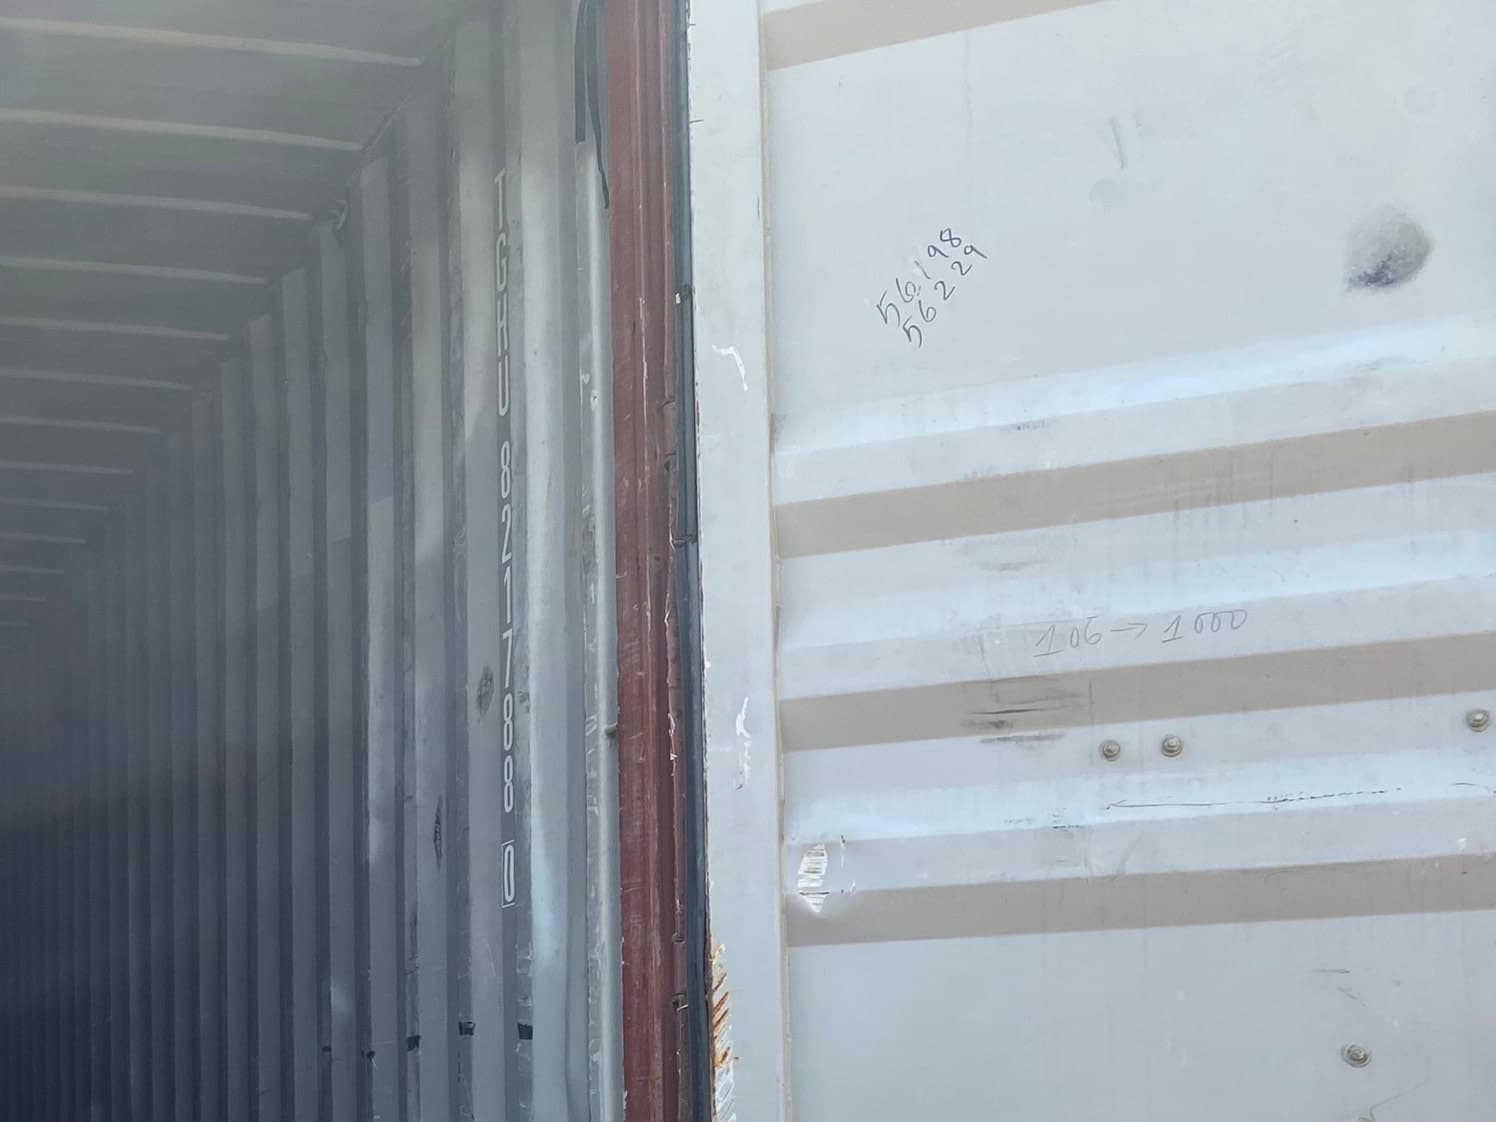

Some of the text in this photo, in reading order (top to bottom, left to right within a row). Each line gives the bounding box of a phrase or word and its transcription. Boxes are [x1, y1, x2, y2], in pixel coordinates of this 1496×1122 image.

[877, 228, 962, 328] 56198
[903, 245, 988, 348] 56229
[501, 441, 514, 813] 821788
